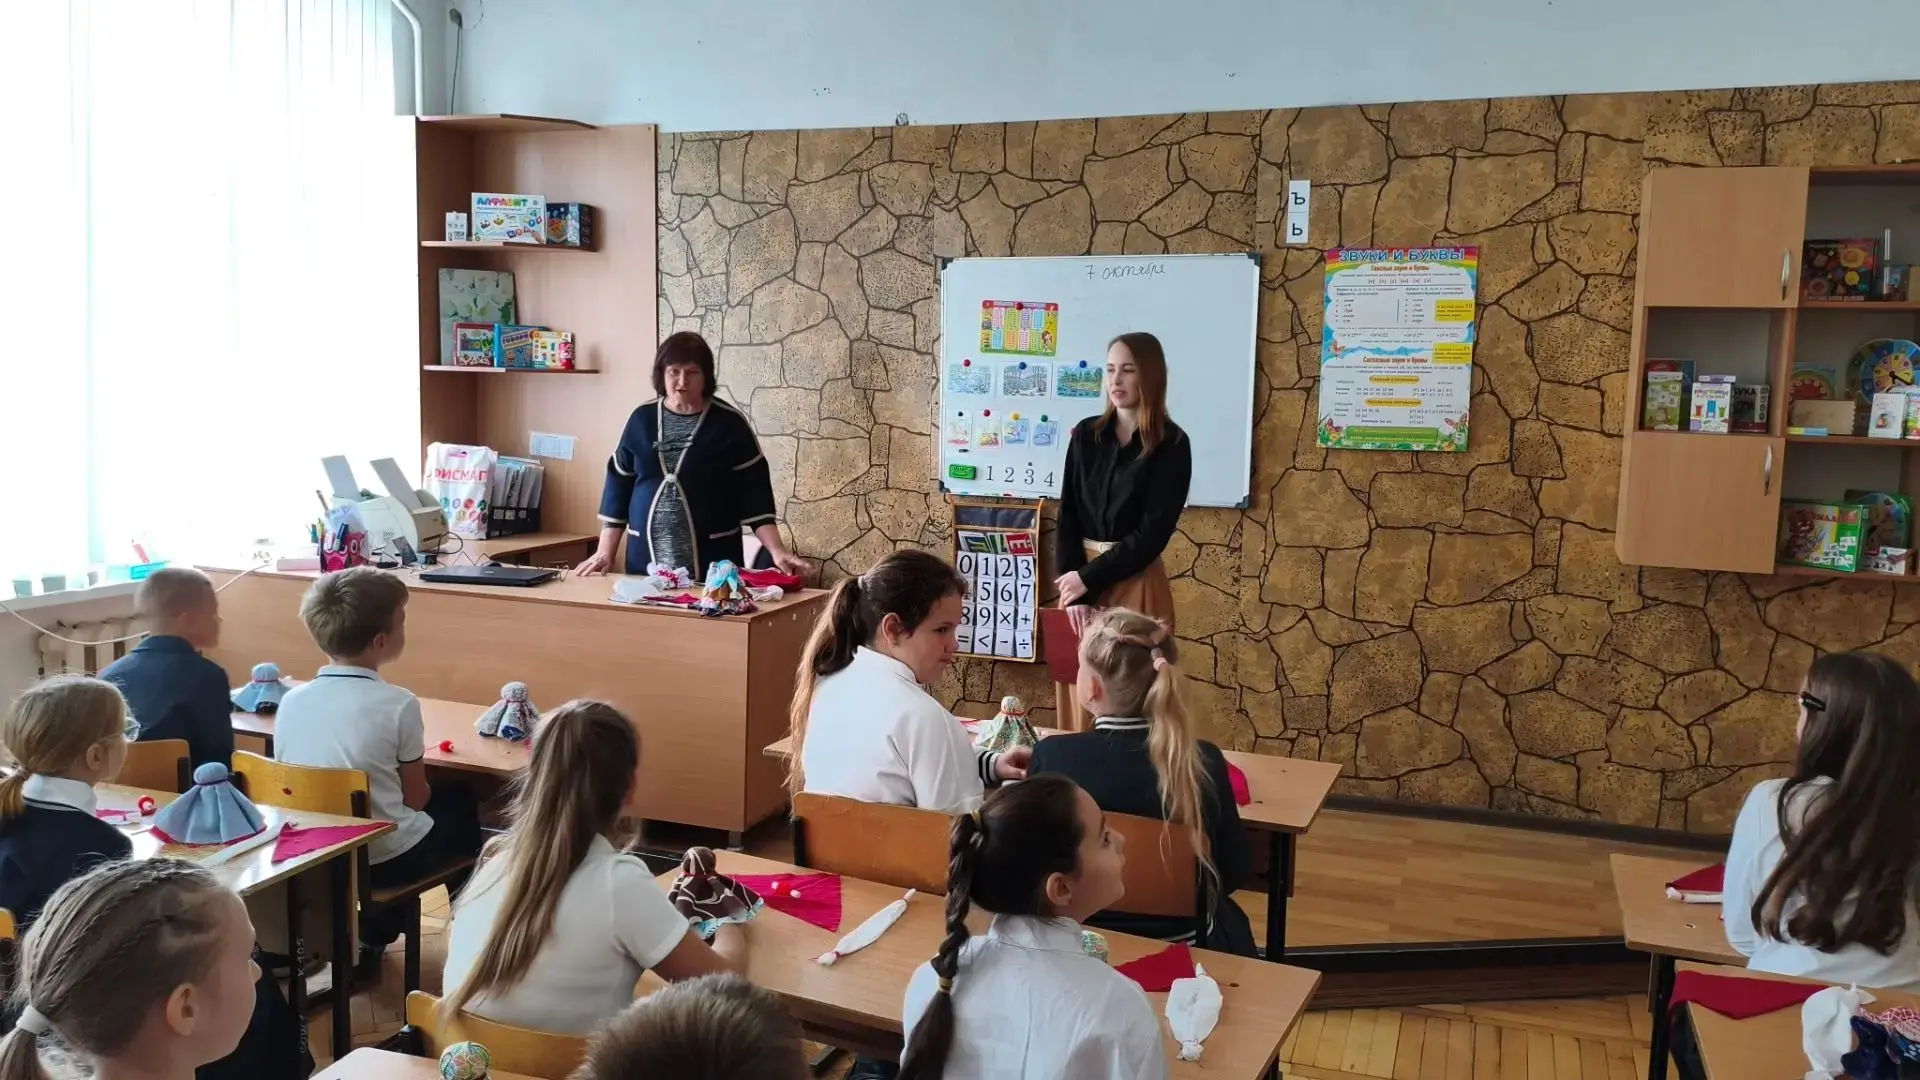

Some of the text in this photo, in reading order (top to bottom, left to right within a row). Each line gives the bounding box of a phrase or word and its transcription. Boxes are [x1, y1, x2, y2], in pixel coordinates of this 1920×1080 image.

[476, 196, 528, 207] АЛФАВИТ
[1291, 192, 1306, 205] Ъ
[1292, 223, 1303, 236] Ь
[1339, 248, 1465, 262] ЗВУКИ И БУКВЫ
[1084, 262, 1166, 280] 7 октября
[986, 465, 1055, 487] 1 2 3 4
[959, 554, 1032, 579] 0 1 2 3
[980, 582, 991, 601] 5
[1000, 582, 1012, 602] 6
[1020, 584, 1031, 604] 7
[979, 607, 991, 626] 9
